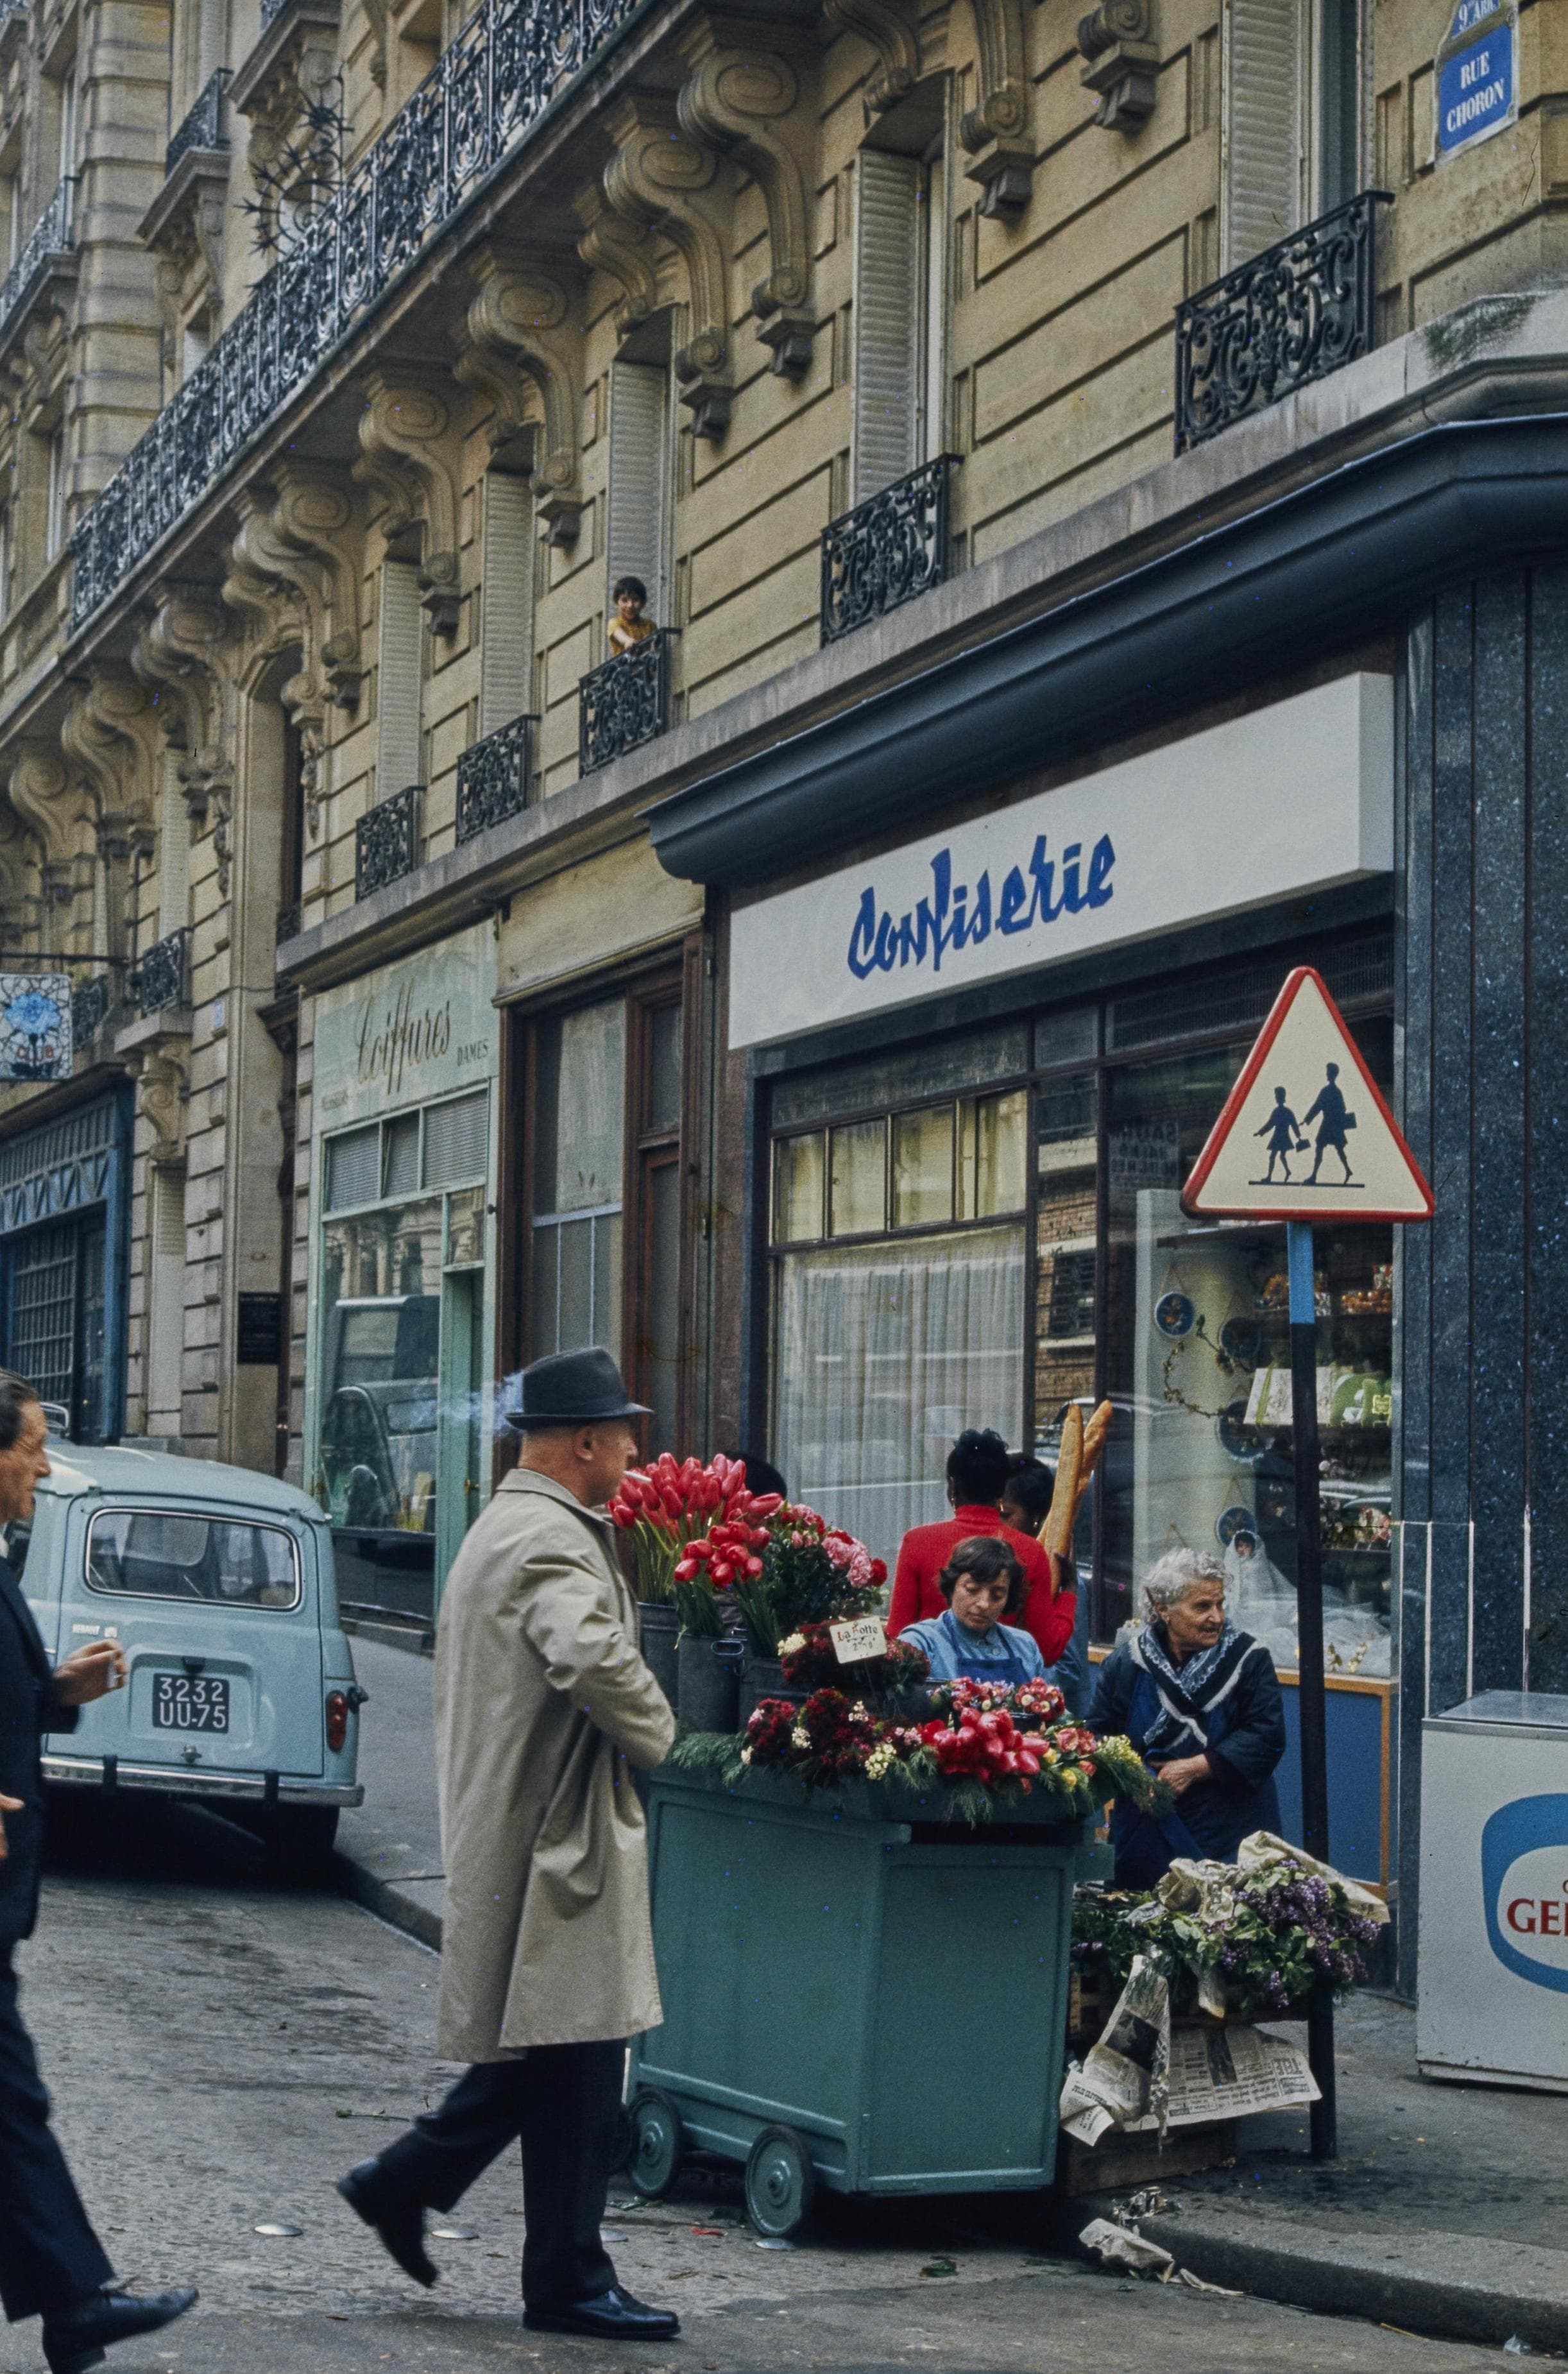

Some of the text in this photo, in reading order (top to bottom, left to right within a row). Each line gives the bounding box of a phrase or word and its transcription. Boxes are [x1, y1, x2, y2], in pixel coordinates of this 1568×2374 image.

[1460, 51, 1490, 89] RUE
[1446, 78, 1506, 132] CHORON
[848, 833, 1116, 980] Confiserie
[457, 1038, 489, 1066] DAMES
[159, 1677, 223, 1703] 3232
[160, 1702, 226, 1729] UU-75
[1506, 1897, 1568, 1937] GE
